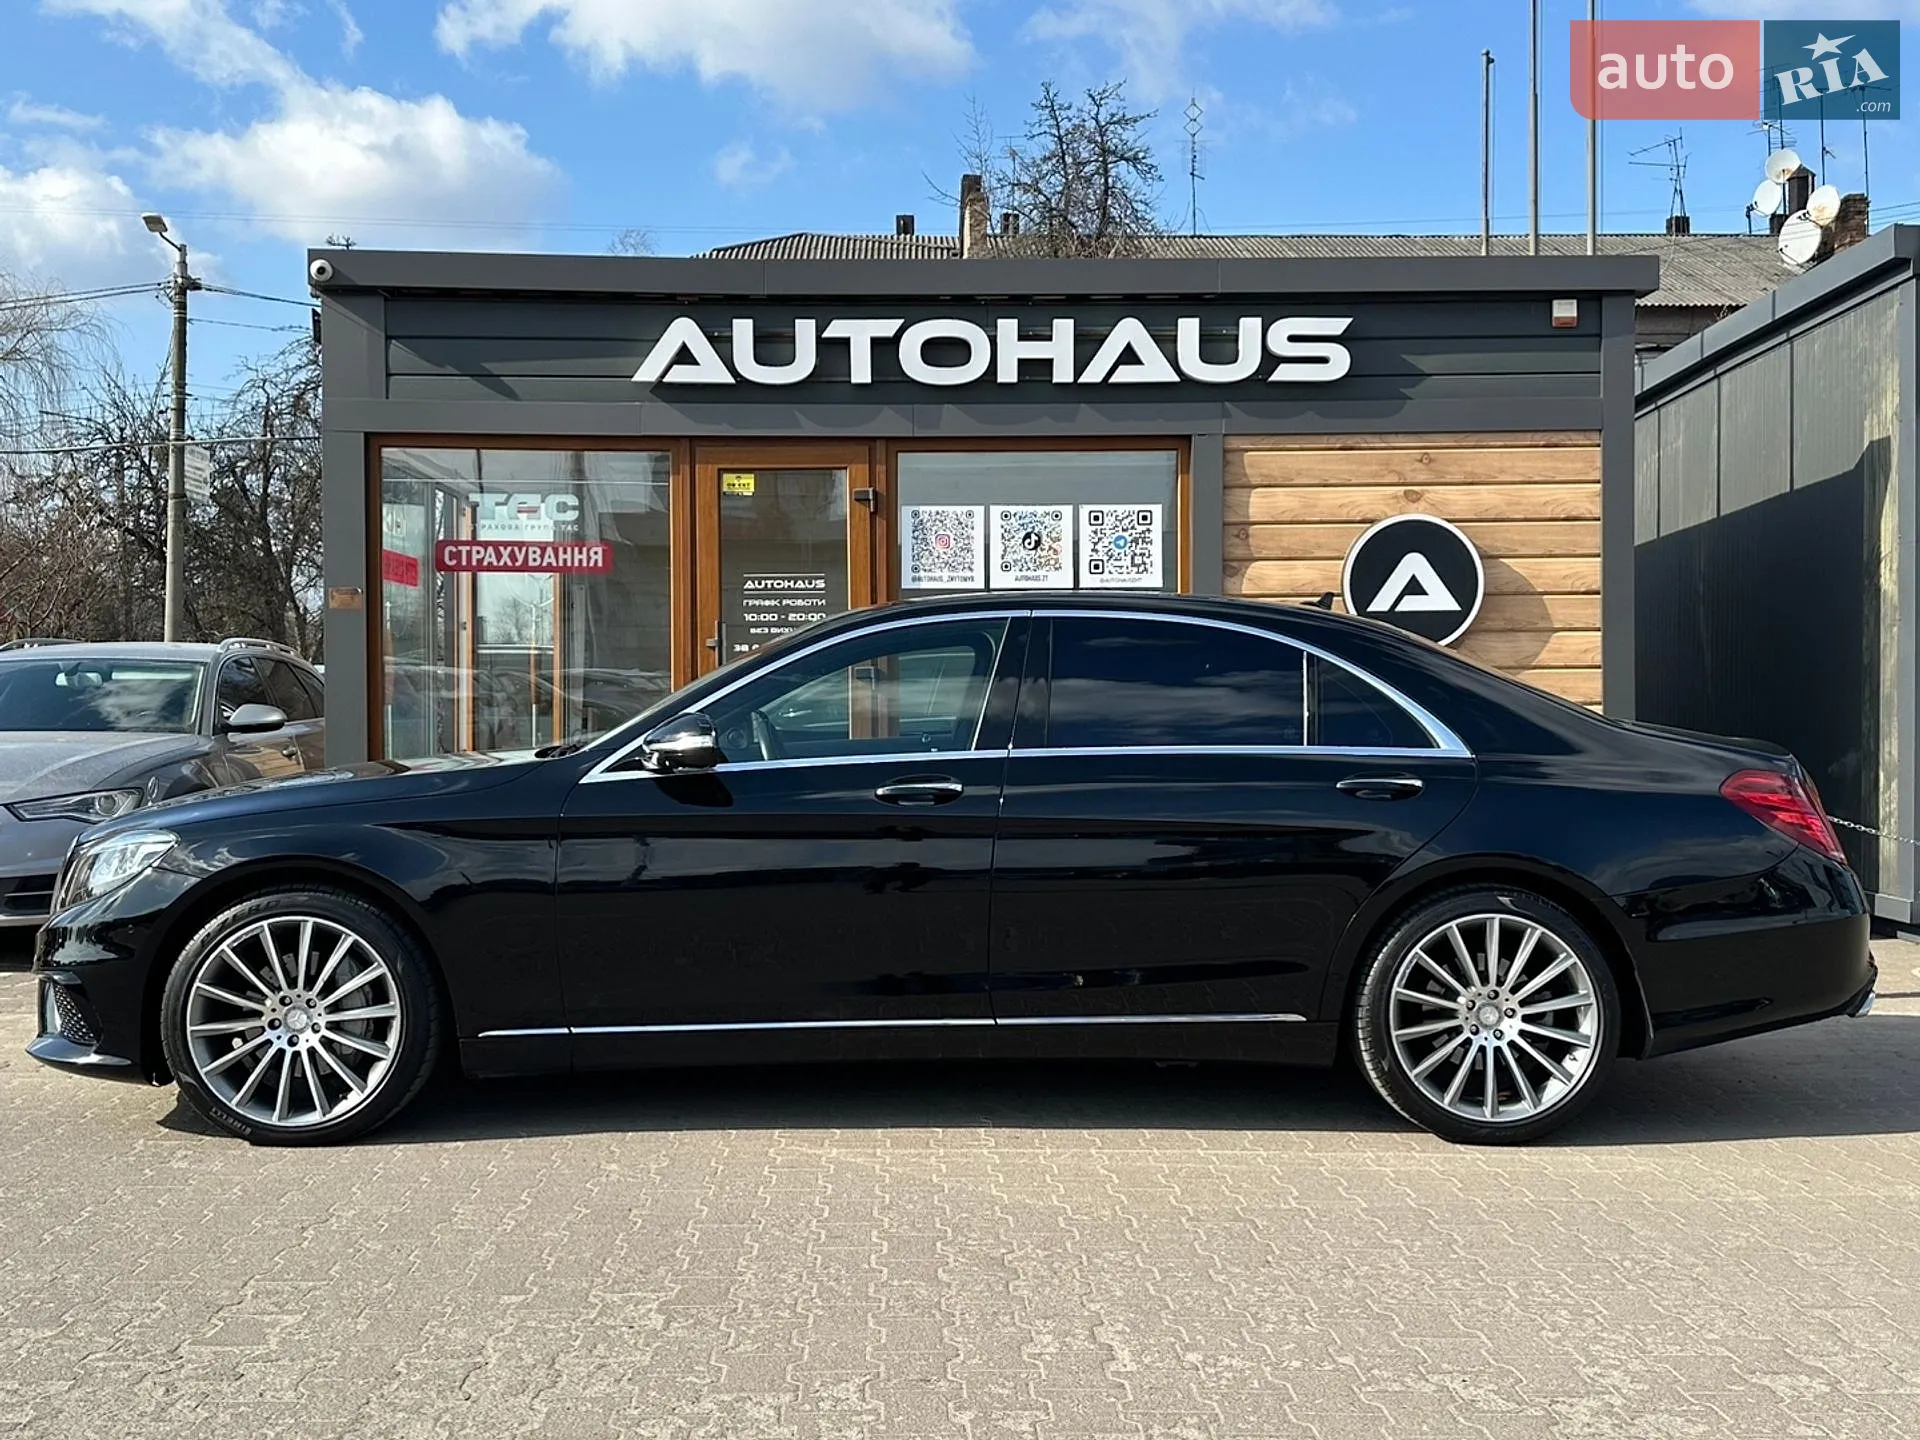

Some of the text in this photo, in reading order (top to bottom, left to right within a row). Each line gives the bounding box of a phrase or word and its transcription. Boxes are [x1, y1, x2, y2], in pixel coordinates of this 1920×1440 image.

[631, 316, 1353, 385] AUTOHAUS
[443, 546, 603, 568] СТРАХУВАННЯ
[743, 579, 826, 589] AUTOHAUS
[782, 599, 826, 607] РОБОТИ
[744, 613, 778, 622] 10:00
